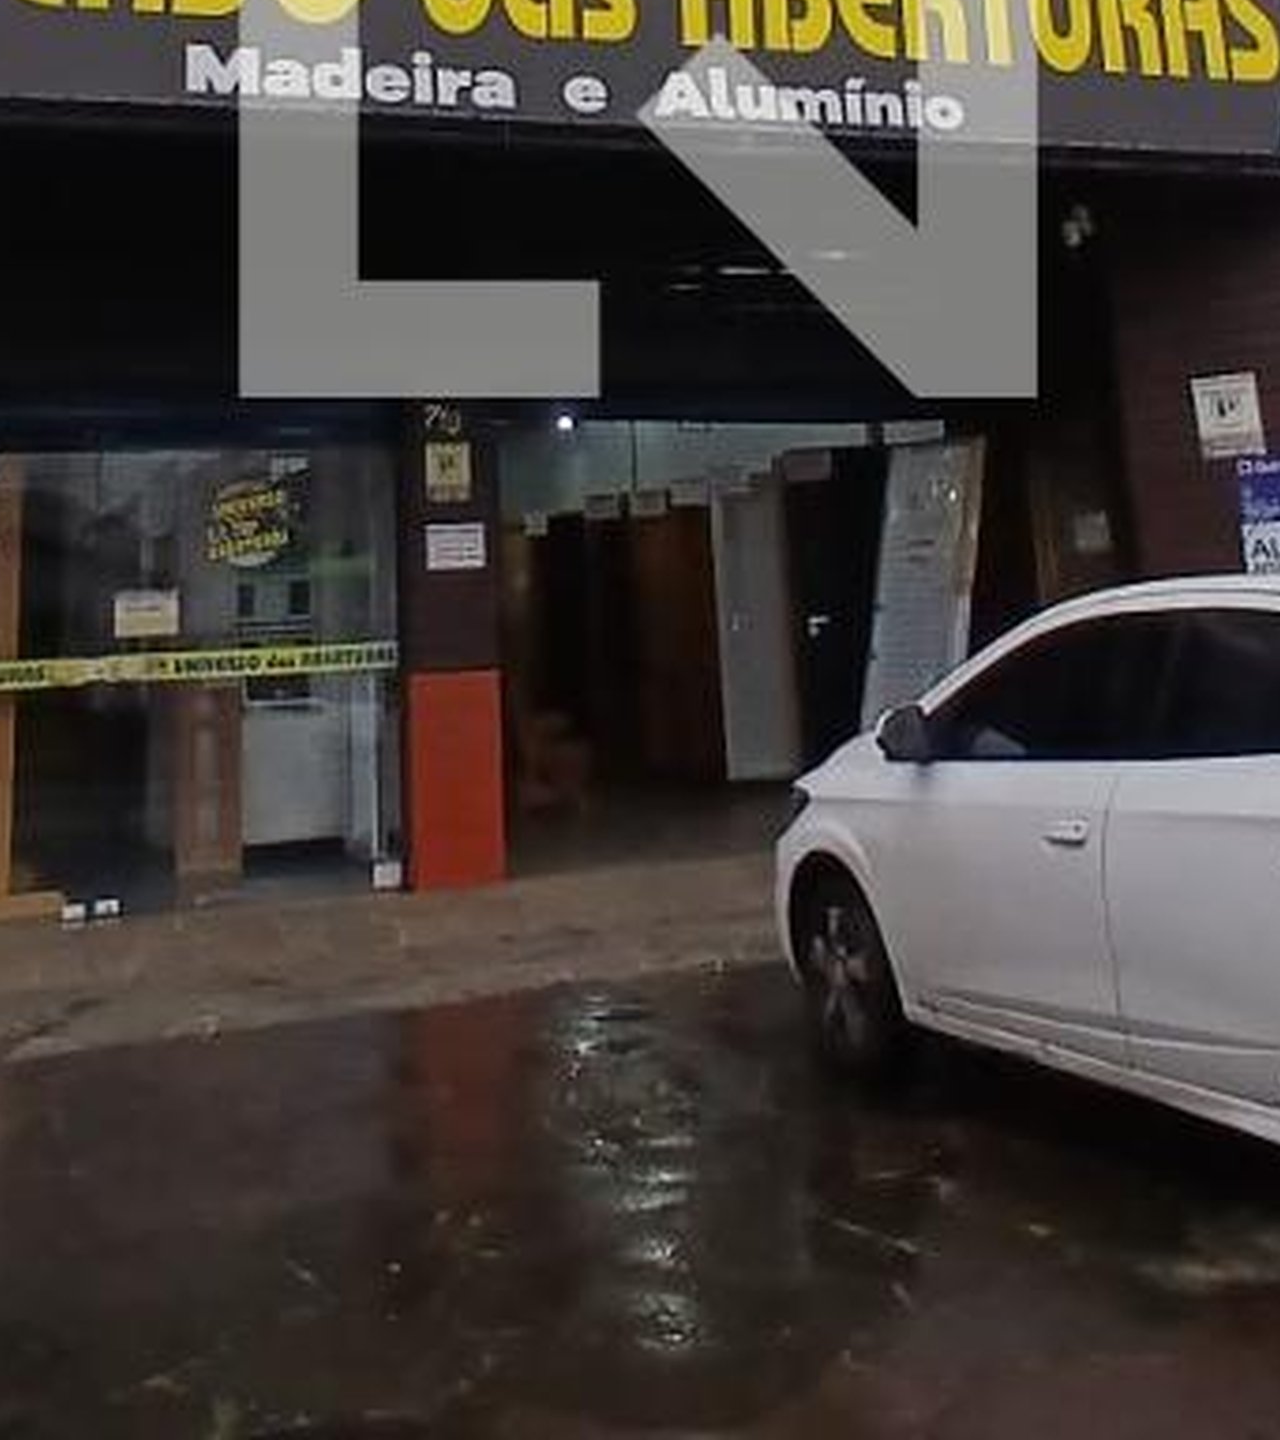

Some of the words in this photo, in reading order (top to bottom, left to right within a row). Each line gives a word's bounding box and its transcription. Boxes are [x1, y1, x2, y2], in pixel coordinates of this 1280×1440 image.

[185, 44, 517, 109] Madeira
[563, 76, 608, 113] e
[654, 67, 966, 130] Alumínio
